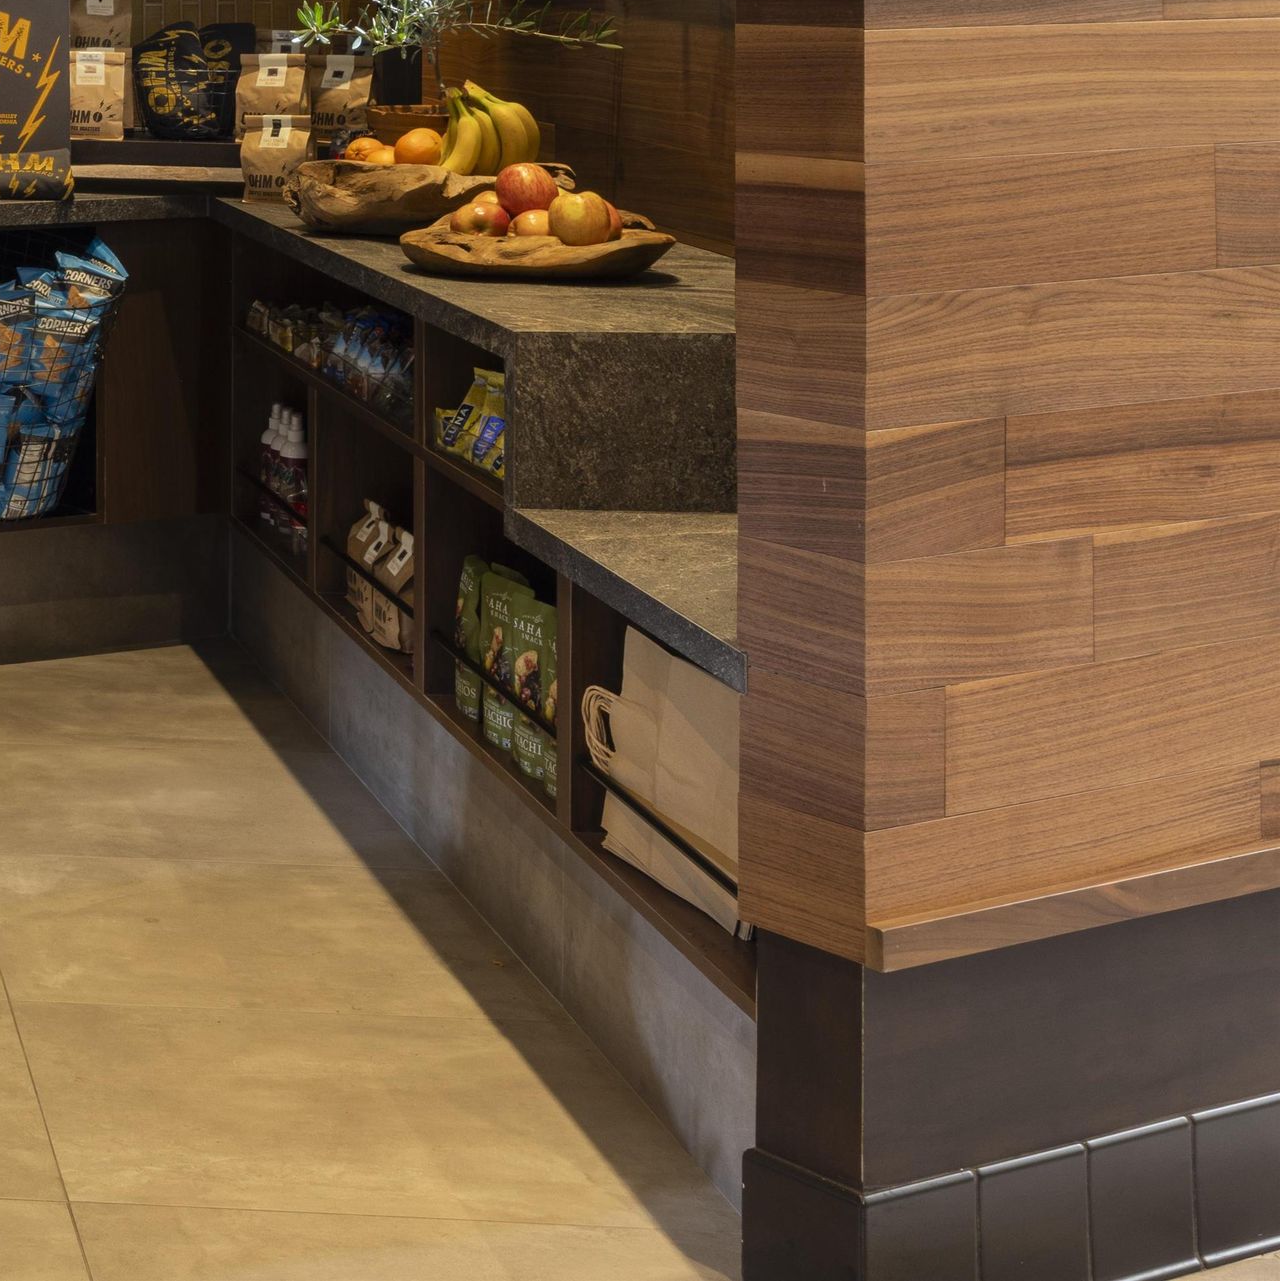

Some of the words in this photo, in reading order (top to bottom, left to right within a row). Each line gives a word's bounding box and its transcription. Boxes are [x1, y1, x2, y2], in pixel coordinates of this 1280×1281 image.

[248, 175, 273, 189] OHM
[65, 269, 113, 290] CORNERS
[38, 317, 89, 334] CORNERS
[444, 406, 470, 444] LUNA
[474, 417, 501, 459] LUNA
